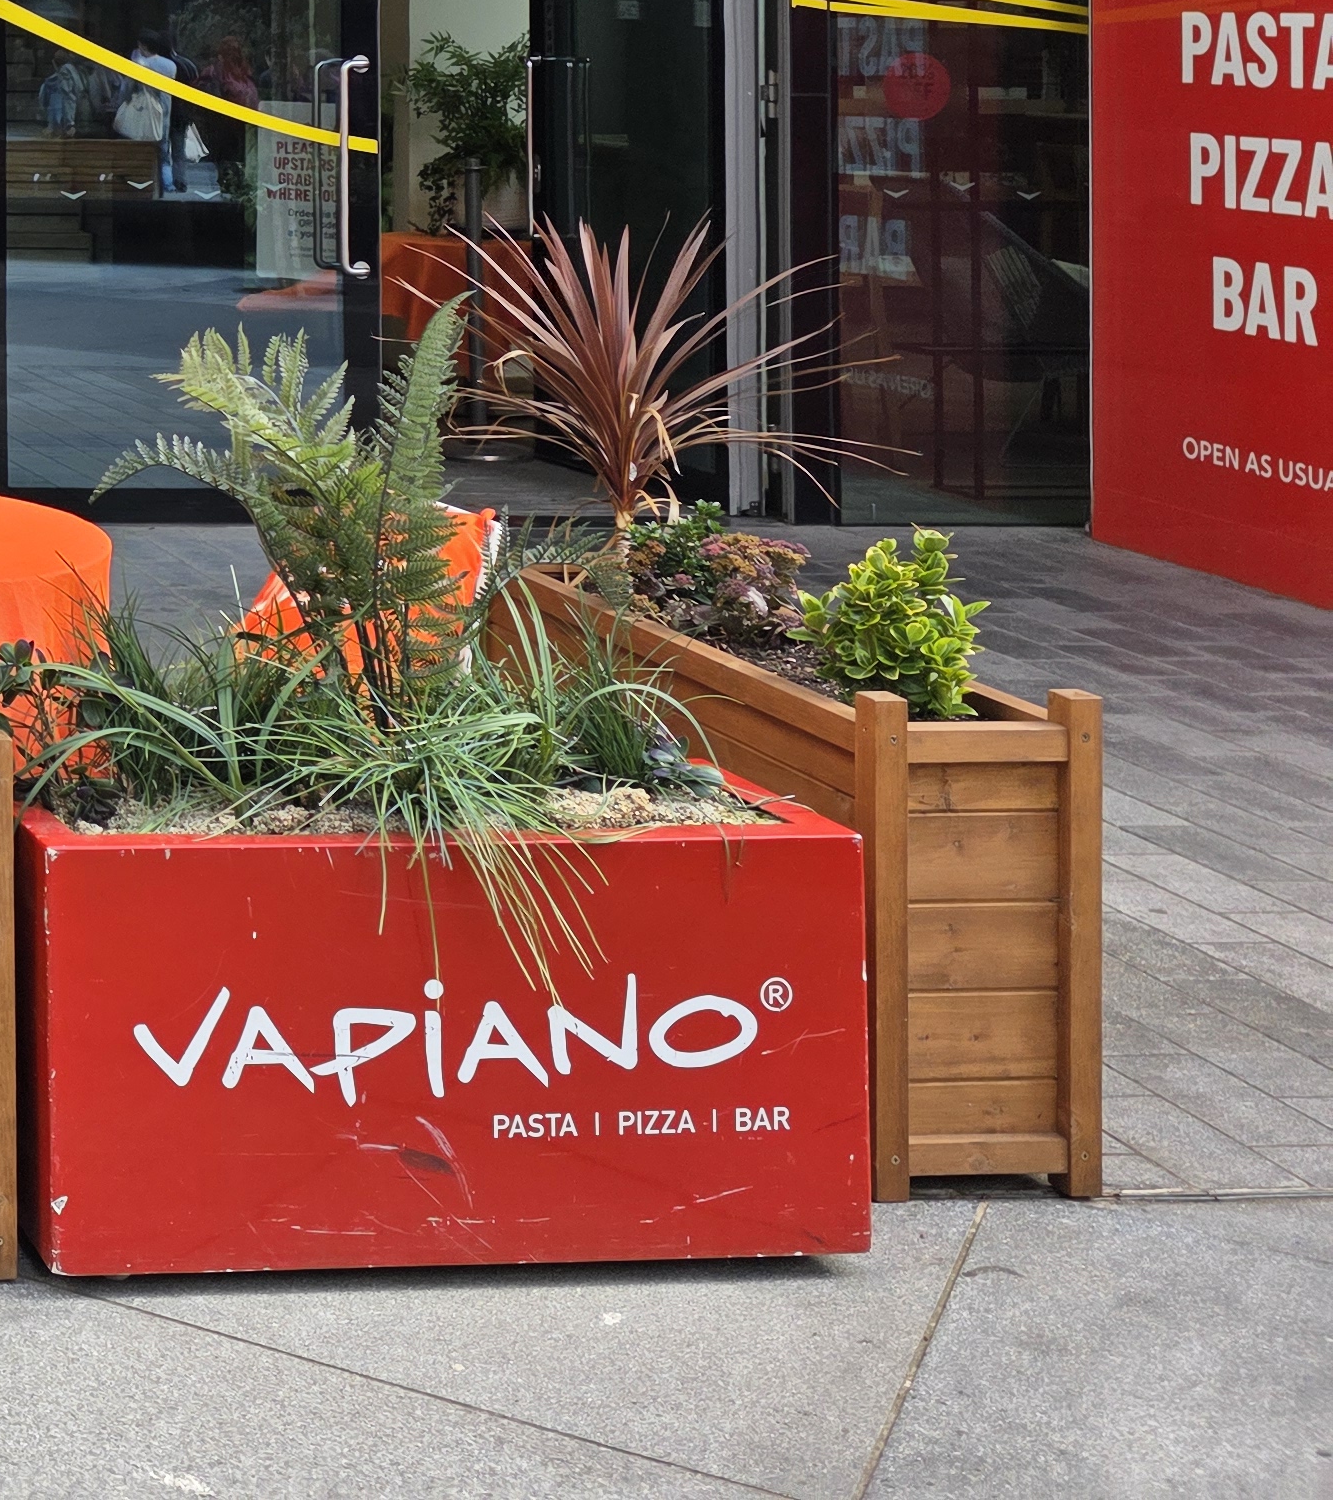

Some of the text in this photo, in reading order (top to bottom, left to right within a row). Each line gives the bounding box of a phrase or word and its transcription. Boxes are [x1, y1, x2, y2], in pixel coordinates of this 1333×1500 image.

[273, 156, 335, 173] UPSTARS
[1190, 132, 1333, 220] PIZZA
[287, 208, 314, 218] Orde
[1212, 255, 1319, 347] BAR
[1183, 436, 1333, 492] OPEN AS USUA
[491, 1111, 579, 1139] PASTA
[617, 1110, 696, 1136] PIZZA
[734, 1107, 791, 1133] BAR
